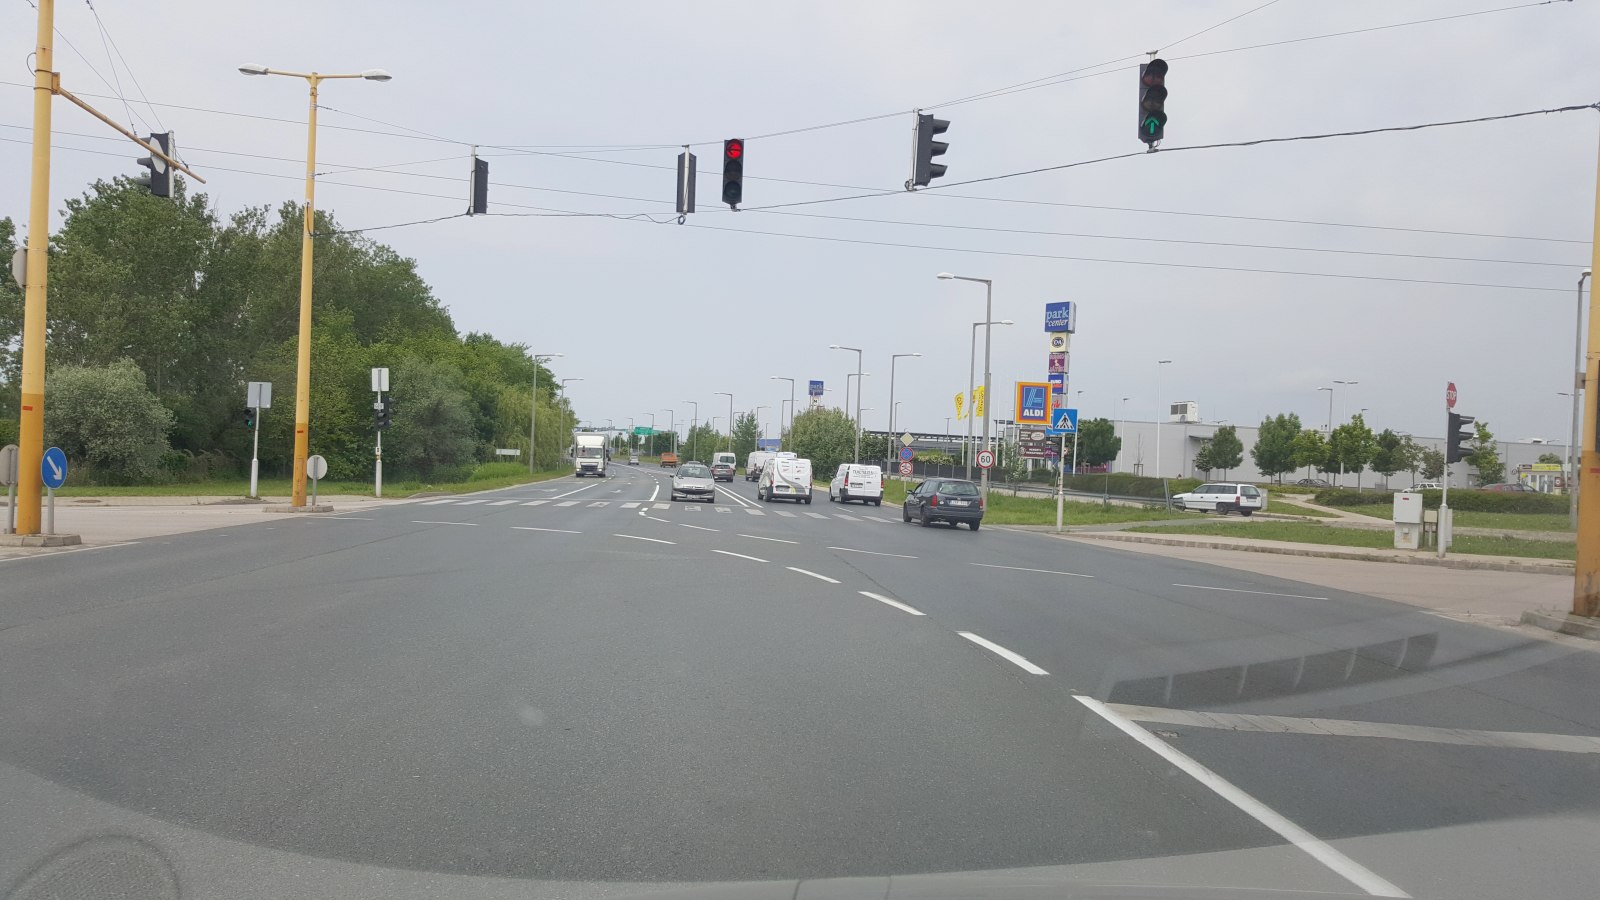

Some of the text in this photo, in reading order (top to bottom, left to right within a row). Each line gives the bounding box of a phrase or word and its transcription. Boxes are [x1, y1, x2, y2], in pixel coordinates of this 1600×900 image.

[1046, 307, 1069, 320] park
[1048, 319, 1068, 327] center
[1446, 390, 1457, 401] STOP
[1023, 409, 1044, 417] ALDI
[980, 455, 991, 464] 60
